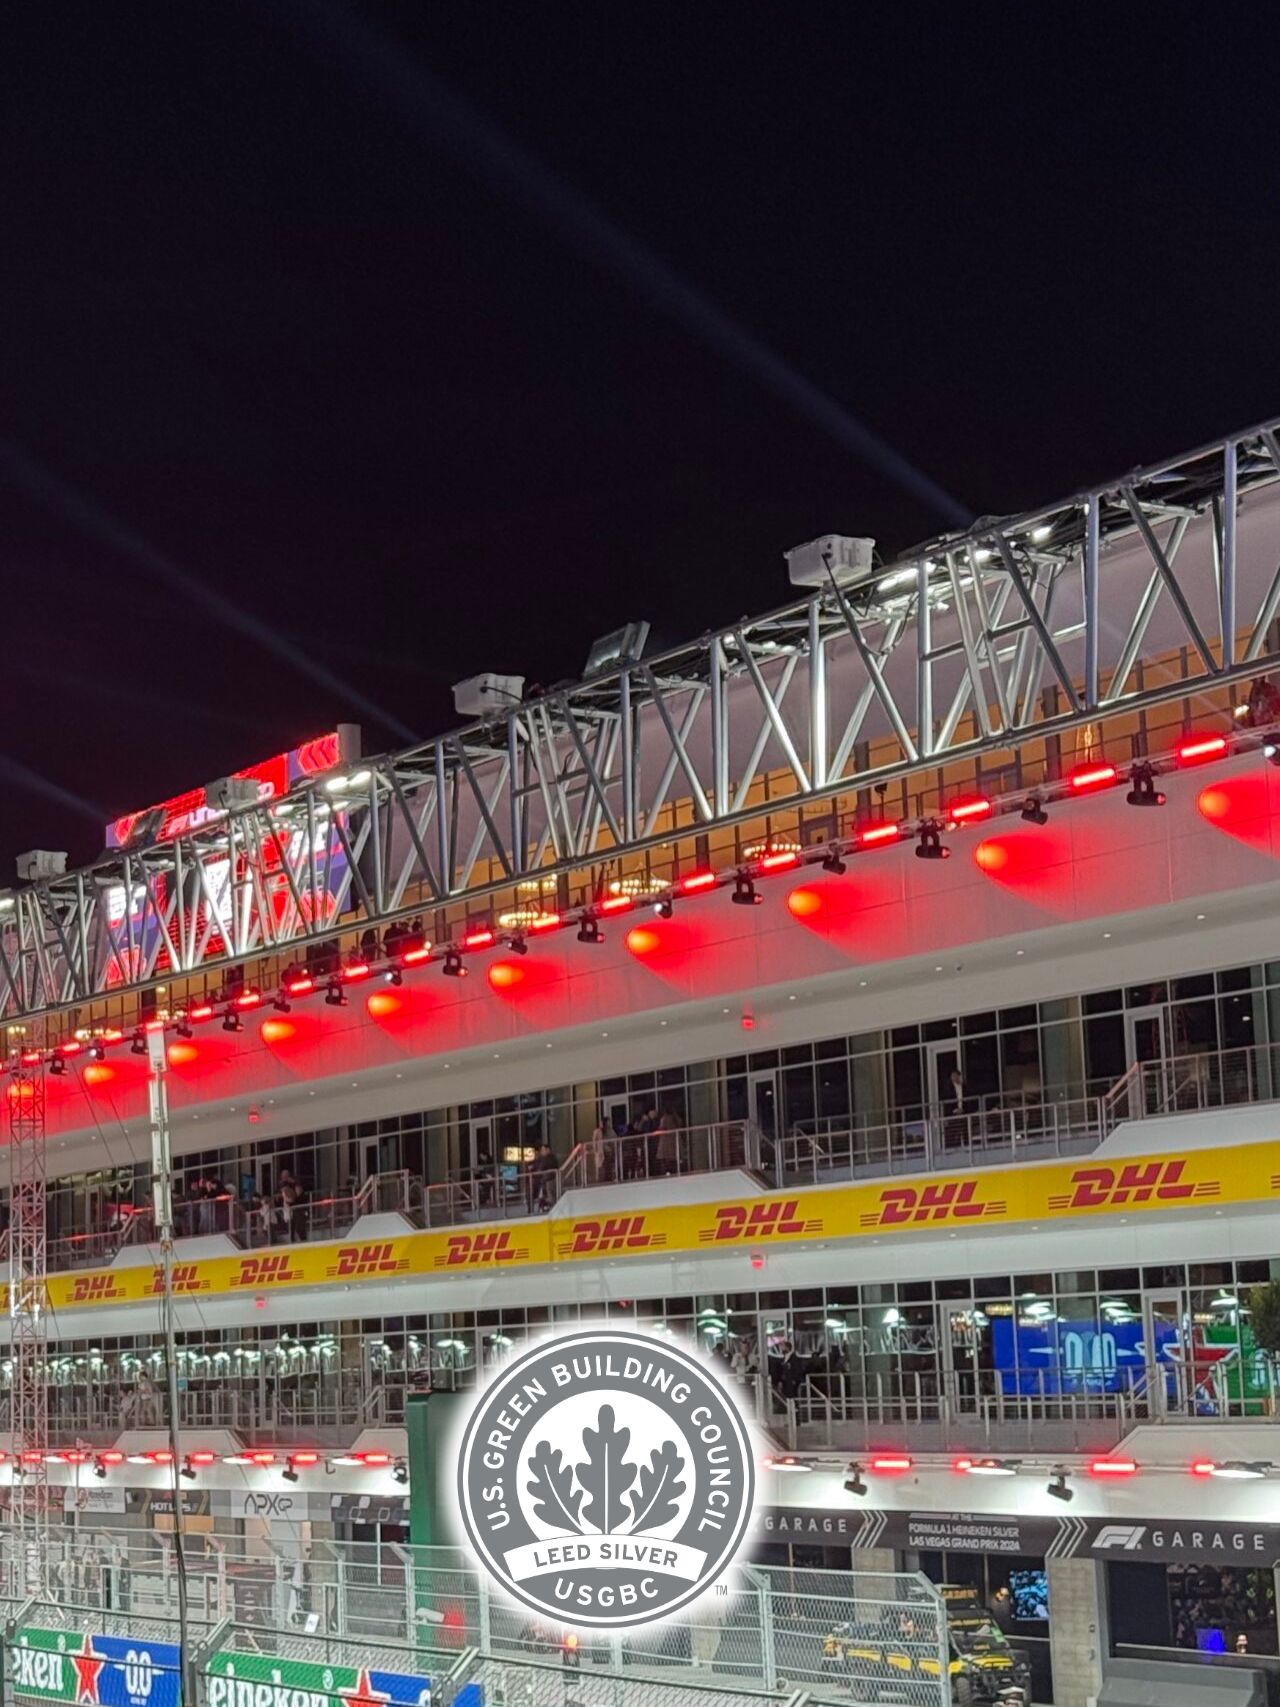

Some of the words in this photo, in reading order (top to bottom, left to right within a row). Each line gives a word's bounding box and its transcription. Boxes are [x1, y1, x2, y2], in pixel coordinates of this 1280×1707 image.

[1069, 1160, 1201, 1207] DHL
[879, 1181, 989, 1225] DHL
[572, 1216, 652, 1253] DHL
[715, 1201, 807, 1240] DHL
[337, 1243, 398, 1275] DHL
[447, 1232, 516, 1265] DHL
[152, 1266, 200, 1294] DHL
[239, 1255, 293, 1285] DHL
[74, 1275, 119, 1302] DHL
[150, 1503, 168, 1512] HOT
[764, 1516, 848, 1534] GARAGE
[909, 1523, 946, 1535] FORMULA
[952, 1525, 992, 1537] HEINEKEN
[992, 1527, 1020, 1538] SILVER
[909, 1535, 924, 1547] LAS
[925, 1536, 951, 1548] VEGAS
[951, 1538, 979, 1549] GRAND
[980, 1539, 999, 1550] PRIX
[1152, 1531, 1265, 1551] GARAGE
